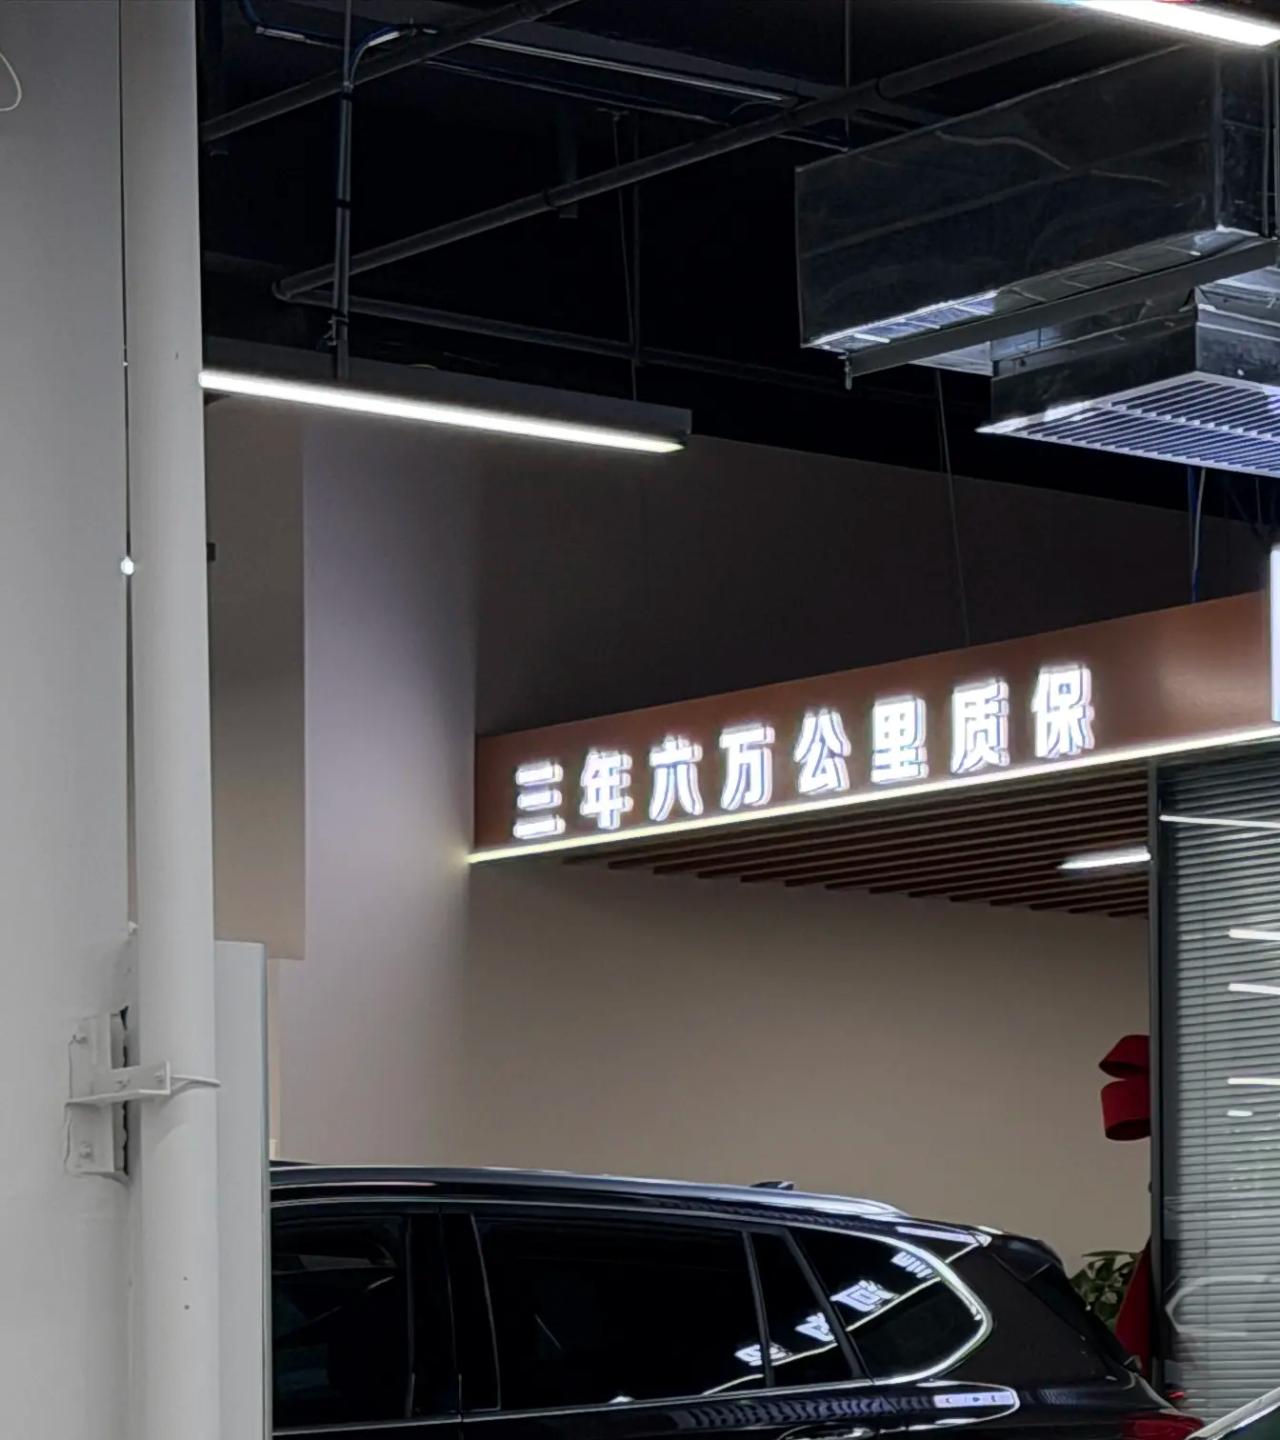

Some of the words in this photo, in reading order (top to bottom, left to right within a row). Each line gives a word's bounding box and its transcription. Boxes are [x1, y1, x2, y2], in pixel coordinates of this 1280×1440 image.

[512, 664, 1094, 839] 三年六万公里质保
